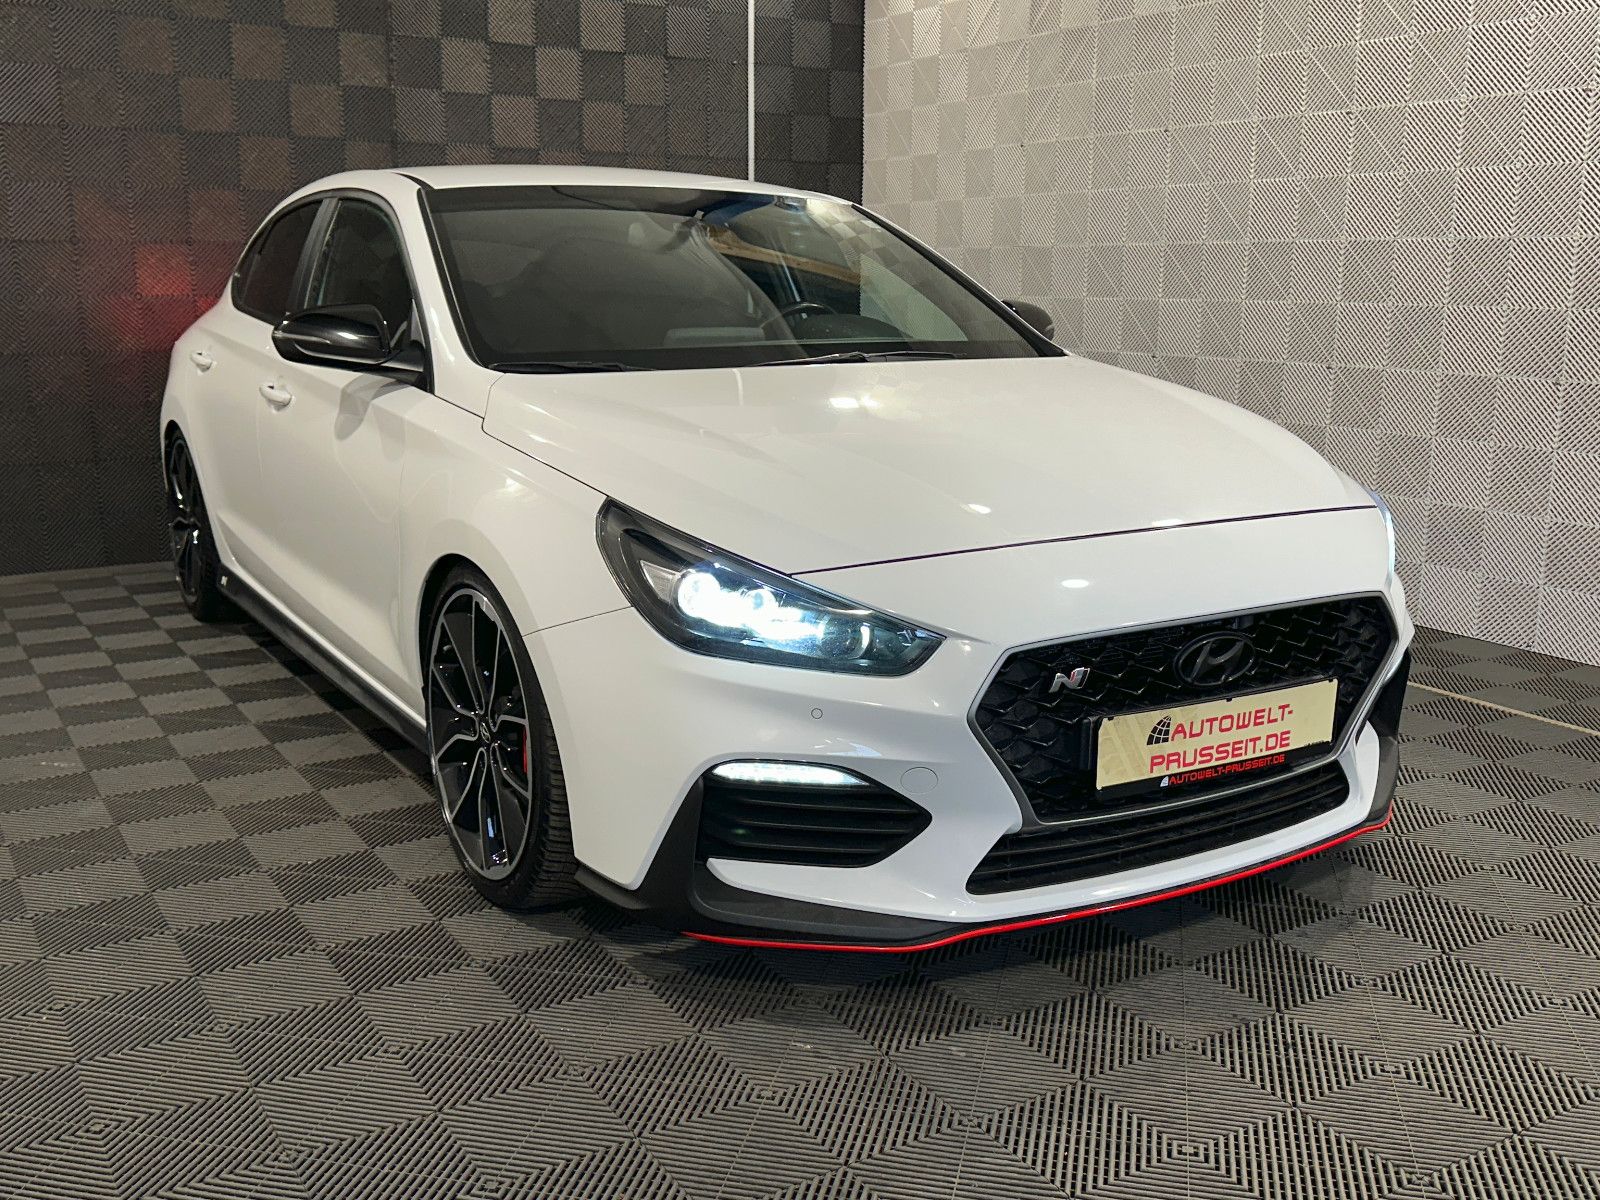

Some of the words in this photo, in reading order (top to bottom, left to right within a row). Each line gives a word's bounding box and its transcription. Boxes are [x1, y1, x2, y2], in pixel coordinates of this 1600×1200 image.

[1050, 667, 1090, 693] N
[1170, 703, 1294, 741] AUTOWELT-
[1150, 730, 1291, 774] PRUSSEIT.DE
[1168, 753, 1286, 786] AUTOWELT-PRUSSEIT.DE
